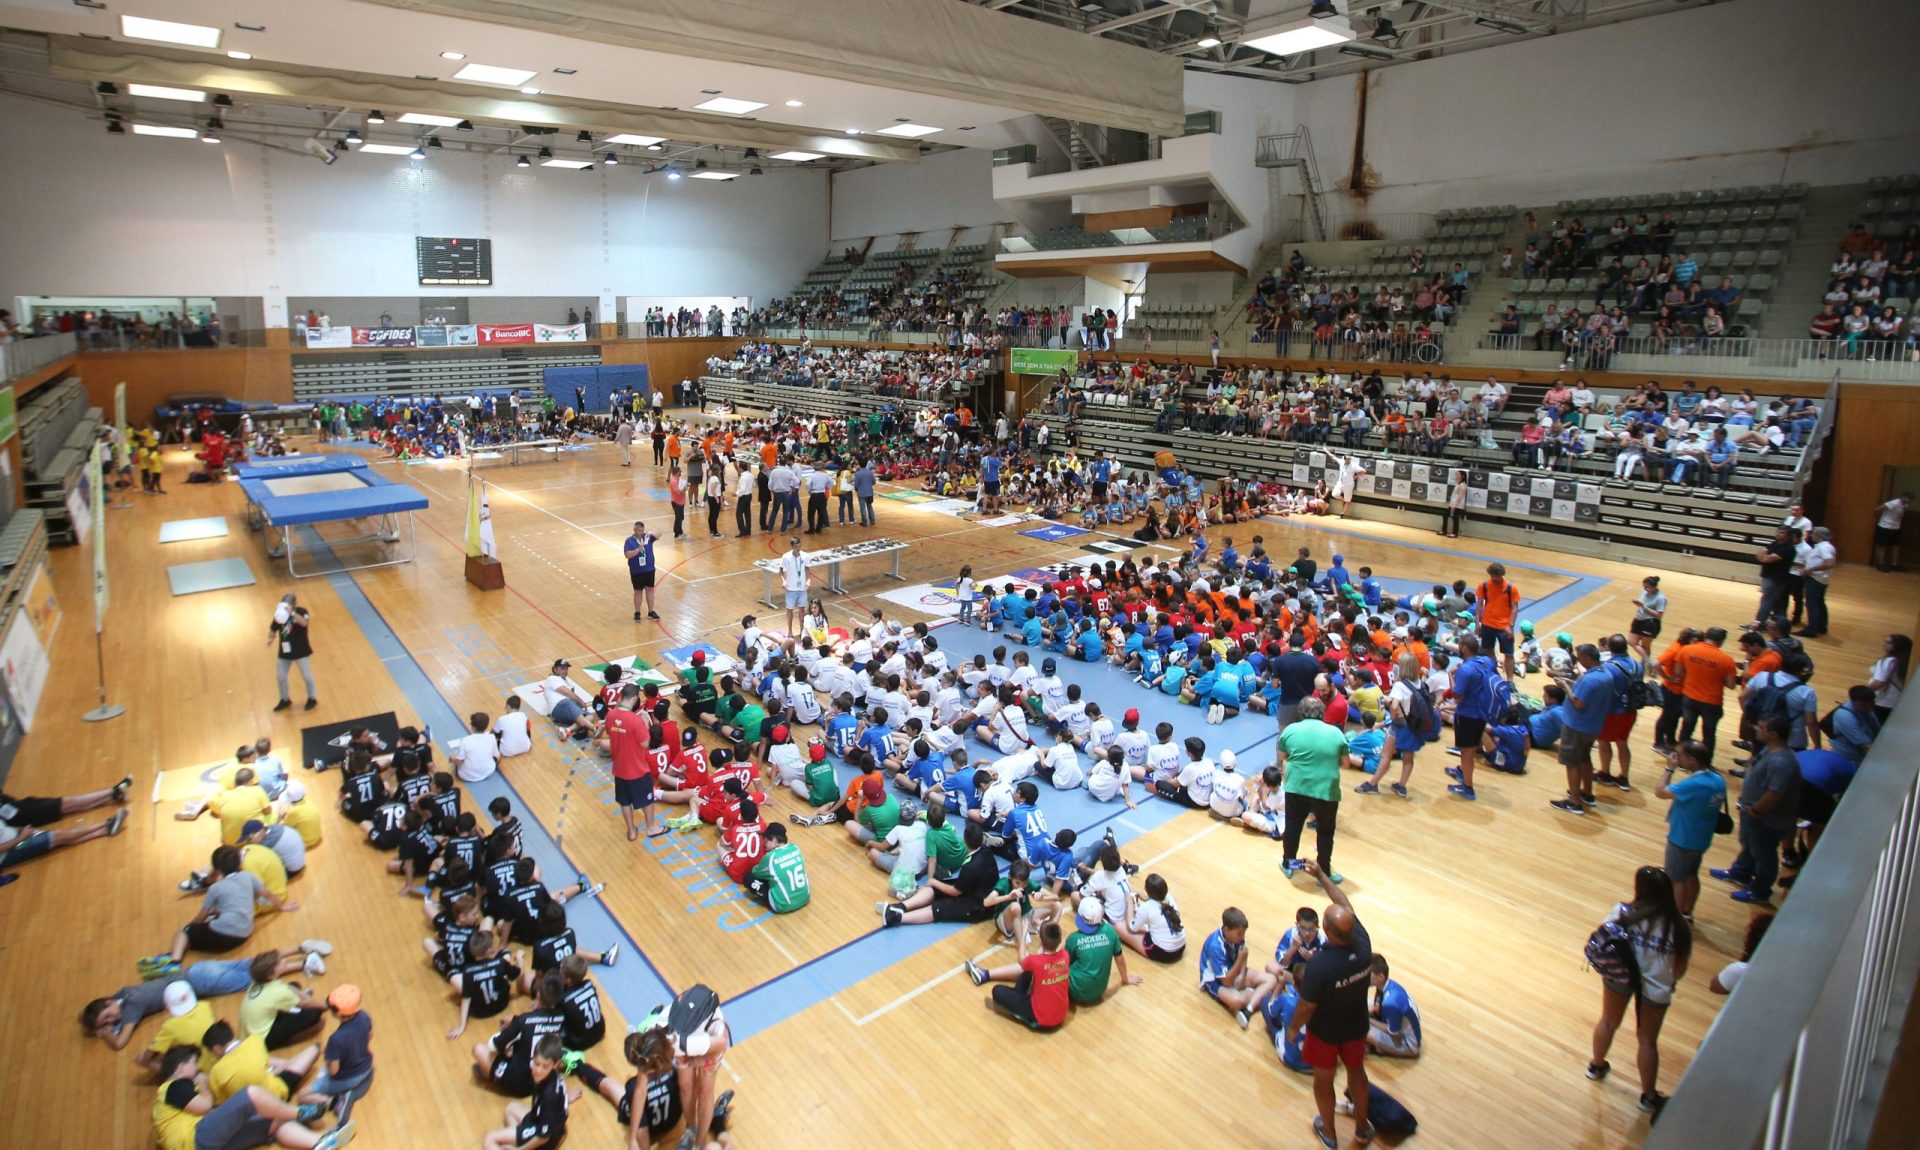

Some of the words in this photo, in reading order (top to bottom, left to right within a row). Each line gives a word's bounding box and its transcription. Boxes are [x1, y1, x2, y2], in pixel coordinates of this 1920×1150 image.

[495, 329, 531, 338] BancoBIC
[1097, 598, 1109, 611] 67
[1132, 611, 1138, 624] 8
[801, 691, 815, 710] 17
[839, 727, 855, 747] 15
[656, 751, 668, 773] 9
[693, 752, 706, 773] 3
[932, 768, 944, 783] 9
[358, 782, 373, 803] 21
[735, 833, 760, 857] 20
[496, 869, 517, 896] 35
[786, 864, 806, 892] 16
[1077, 934, 1108, 945] ANDEBOL
[446, 943, 466, 966] 33
[579, 997, 601, 1030] 38
[648, 1094, 670, 1126] 37
